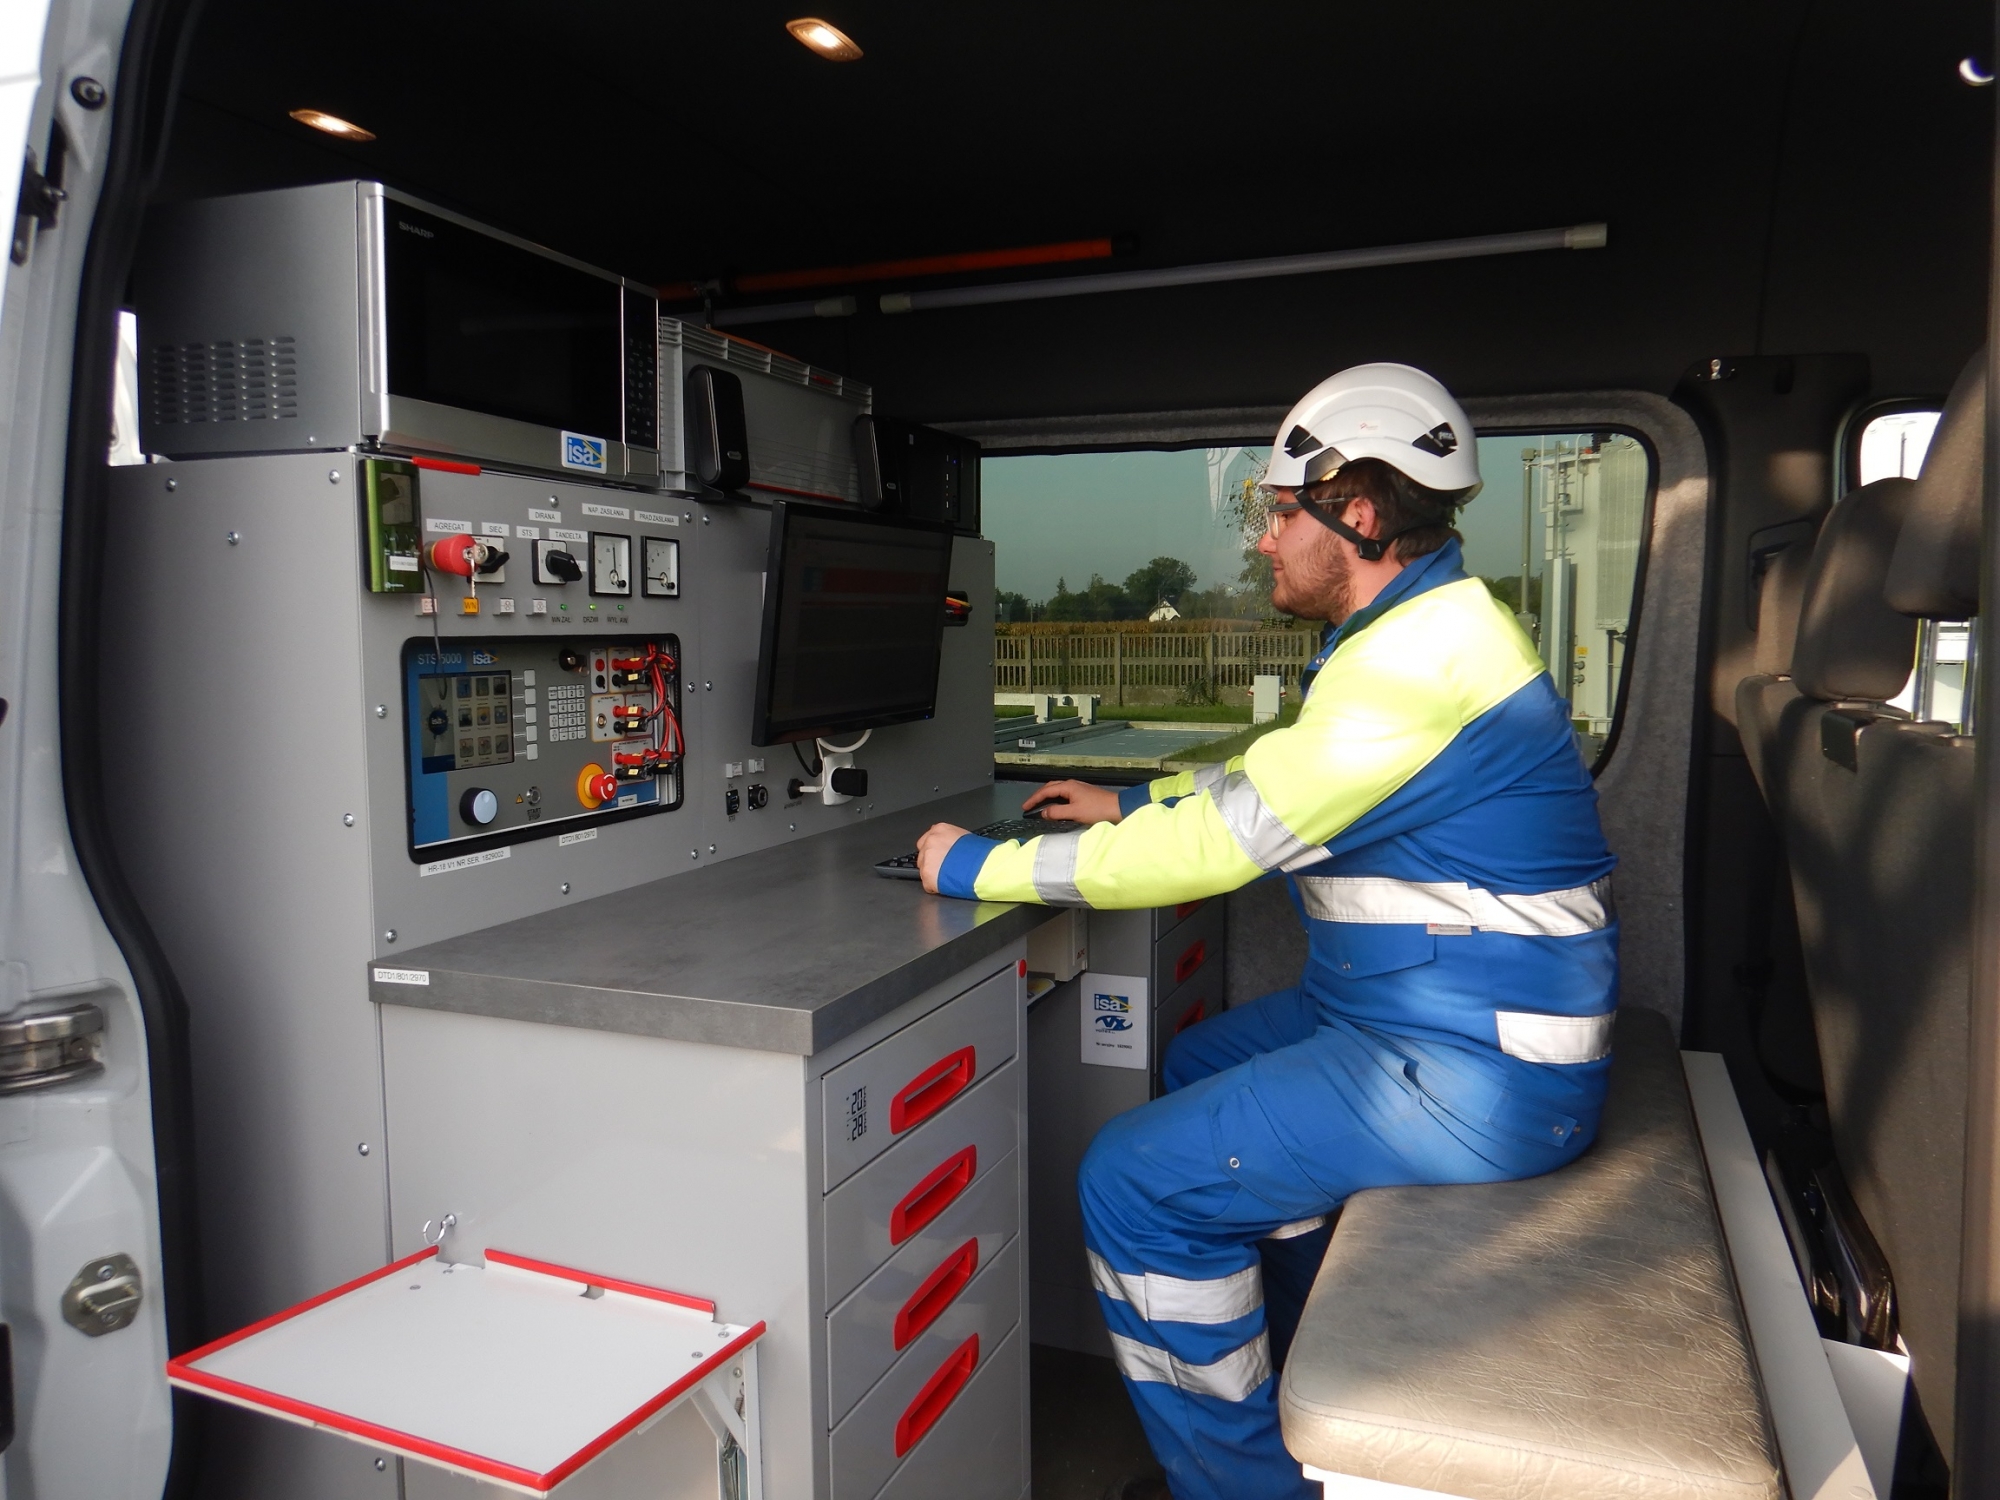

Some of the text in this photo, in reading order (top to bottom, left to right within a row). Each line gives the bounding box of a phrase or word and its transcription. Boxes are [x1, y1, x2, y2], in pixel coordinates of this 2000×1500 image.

[399, 220, 435, 239] SHARP
[568, 438, 594, 465] isa
[535, 511, 556, 520] DIRANA
[600, 508, 625, 517] ZASILANIA
[652, 514, 675, 524] ZASILANIA
[434, 522, 465, 531] AGREGAT
[521, 529, 533, 537] STS
[555, 531, 583, 540] TANDELTA
[464, 601, 477, 609] WN
[418, 652, 462, 665] STS 5000
[473, 651, 491, 665] isa
[428, 864, 446, 873] HR-18
[456, 859, 466, 867] NR
[482, 850, 504, 861] 1829002
[377, 971, 427, 982] DTD1/801/2970
[1095, 994, 1121, 1011] isa
